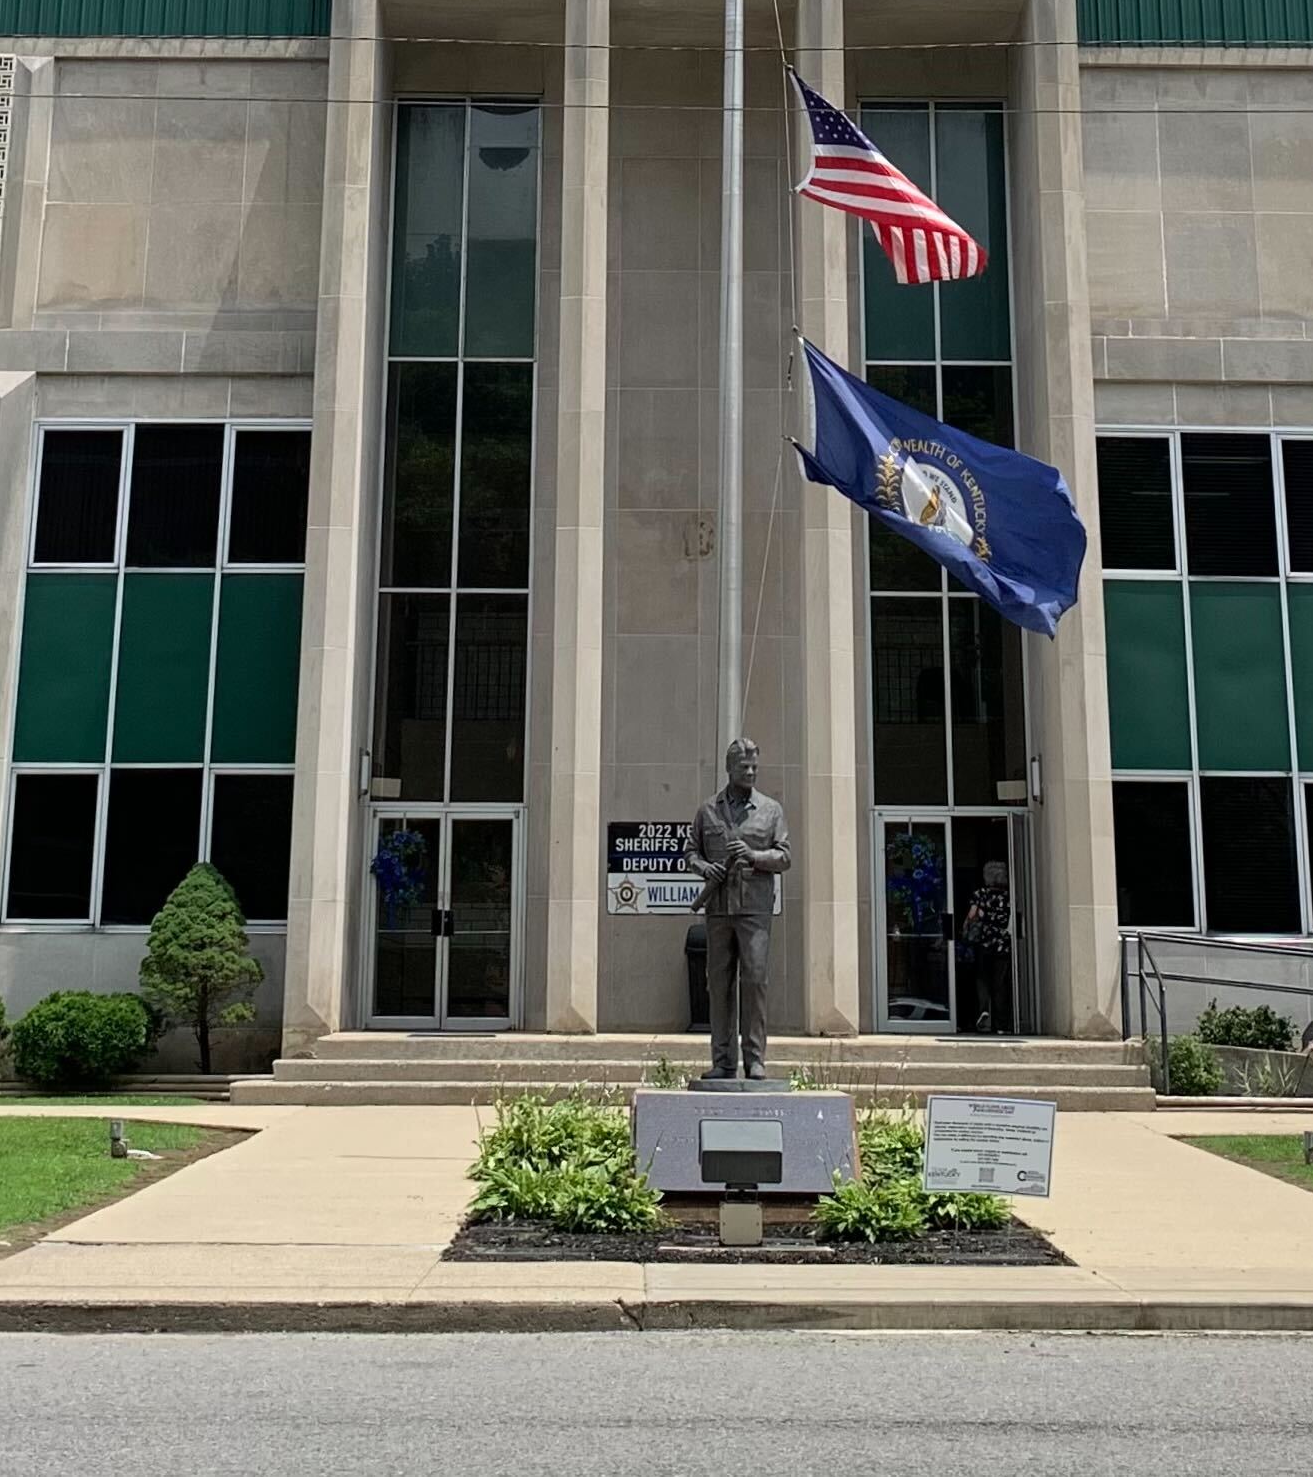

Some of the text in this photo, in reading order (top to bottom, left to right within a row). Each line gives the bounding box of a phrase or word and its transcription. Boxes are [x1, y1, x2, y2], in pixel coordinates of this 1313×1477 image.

[947, 455, 963, 469] OF
[960, 468, 987, 533] KENTUCKY
[639, 824, 672, 838] 2022
[615, 838, 678, 852] SHERIFFS
[622, 858, 673, 871] DEPUTY
[648, 886, 699, 902] WILLIAM
